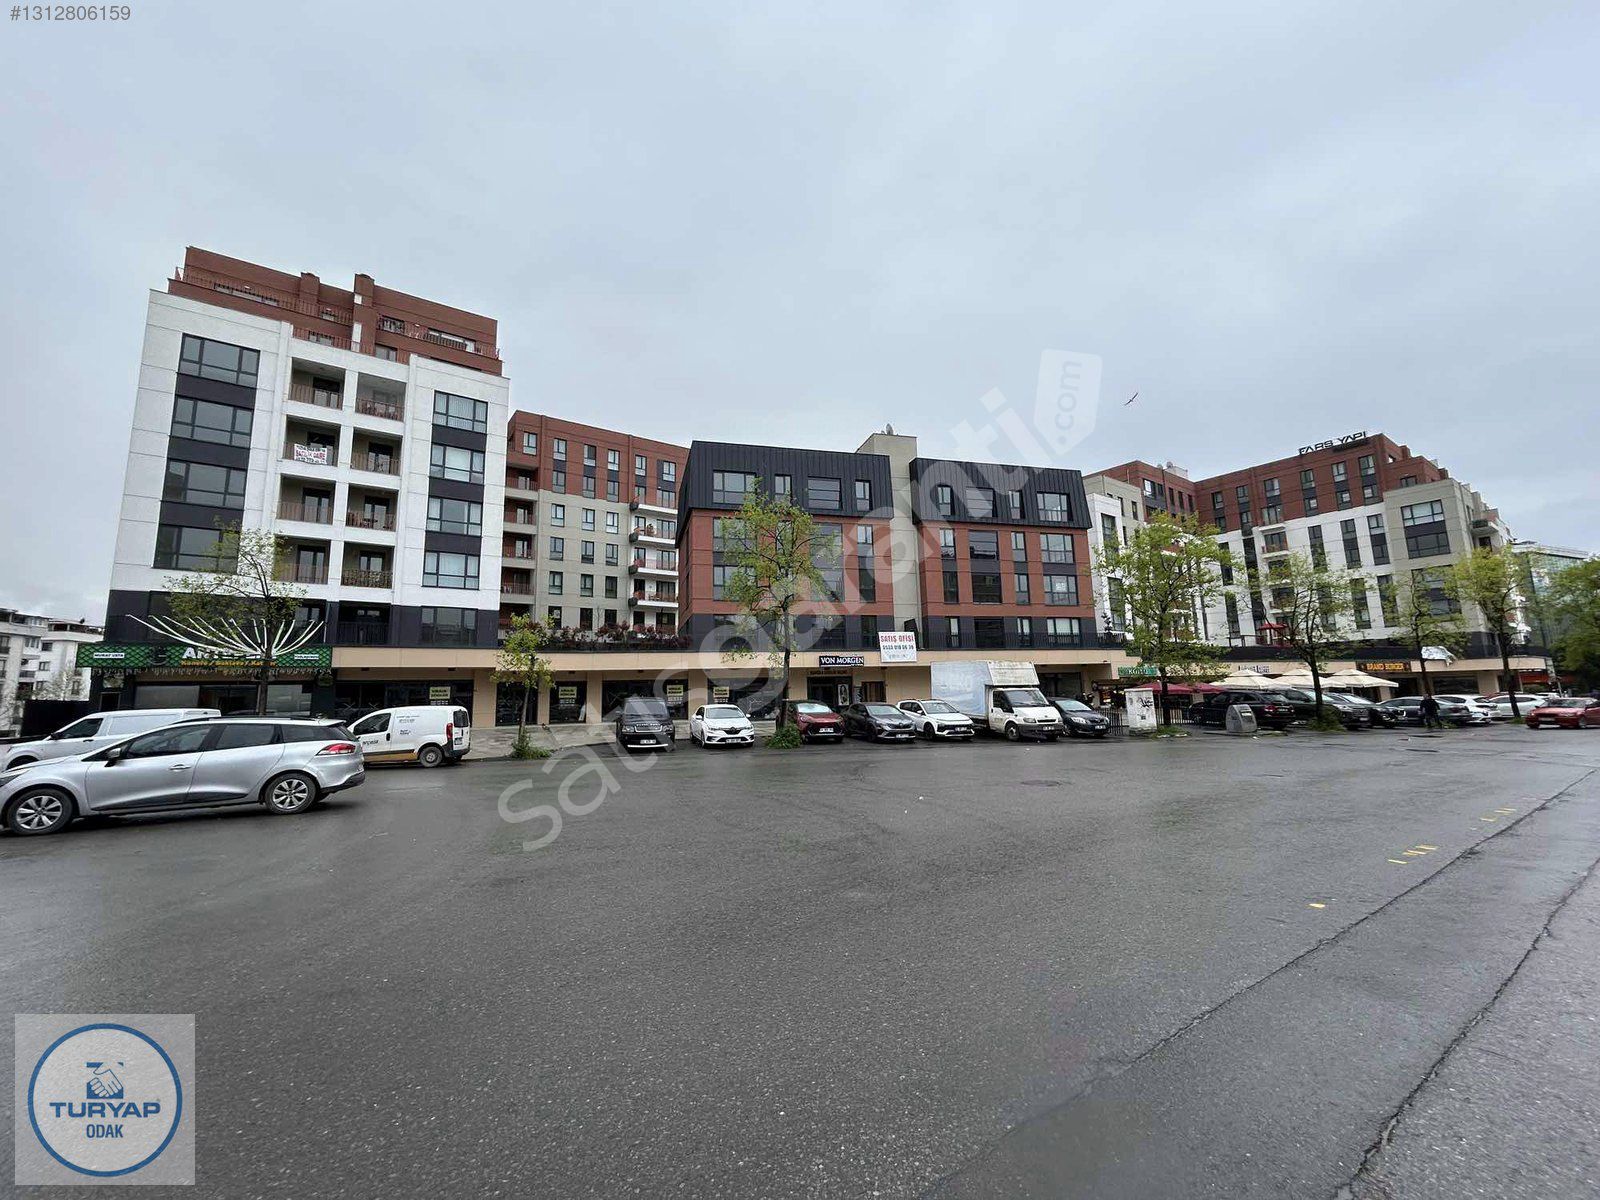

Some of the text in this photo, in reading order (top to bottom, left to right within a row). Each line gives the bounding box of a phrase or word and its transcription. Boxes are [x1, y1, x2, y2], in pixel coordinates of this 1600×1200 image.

[1298, 430, 1367, 455] FARS YAPI
[880, 635, 897, 643] SATIŞ
